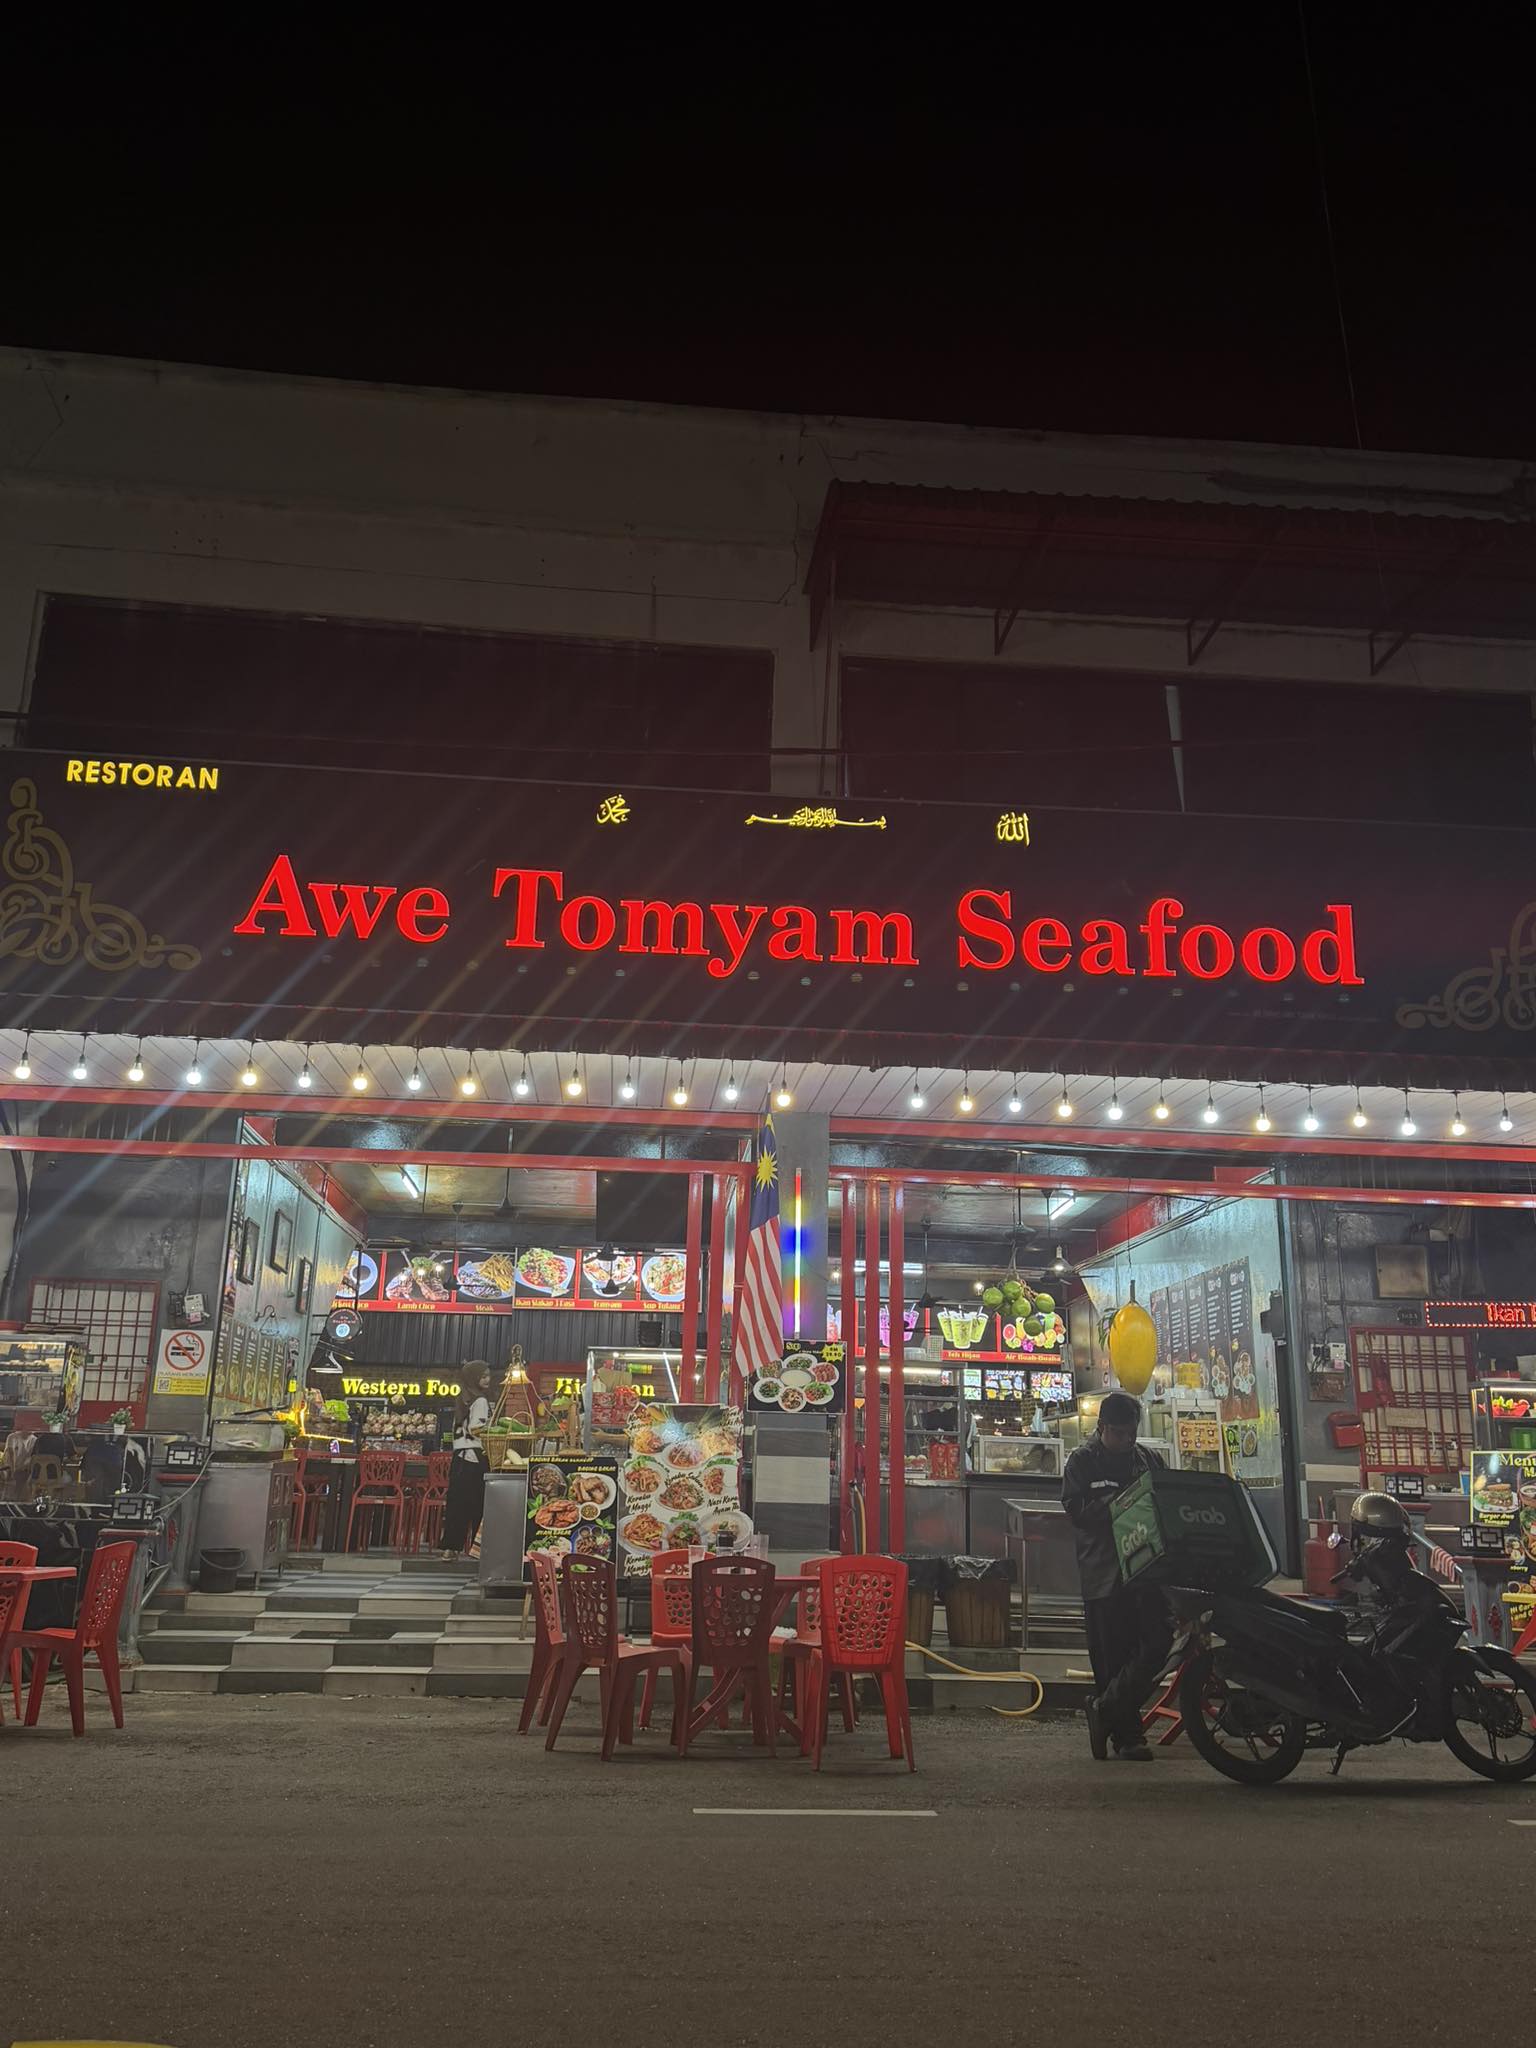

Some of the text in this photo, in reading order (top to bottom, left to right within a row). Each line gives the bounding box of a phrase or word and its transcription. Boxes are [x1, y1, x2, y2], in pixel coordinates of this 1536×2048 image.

[66, 759, 219, 790] RESTORAN
[233, 854, 1365, 987] Awe Tomyam Seafood
[342, 1377, 460, 1396] Western Foo
[1179, 1505, 1225, 1525] Grab
[1121, 1522, 1148, 1555] Grab
